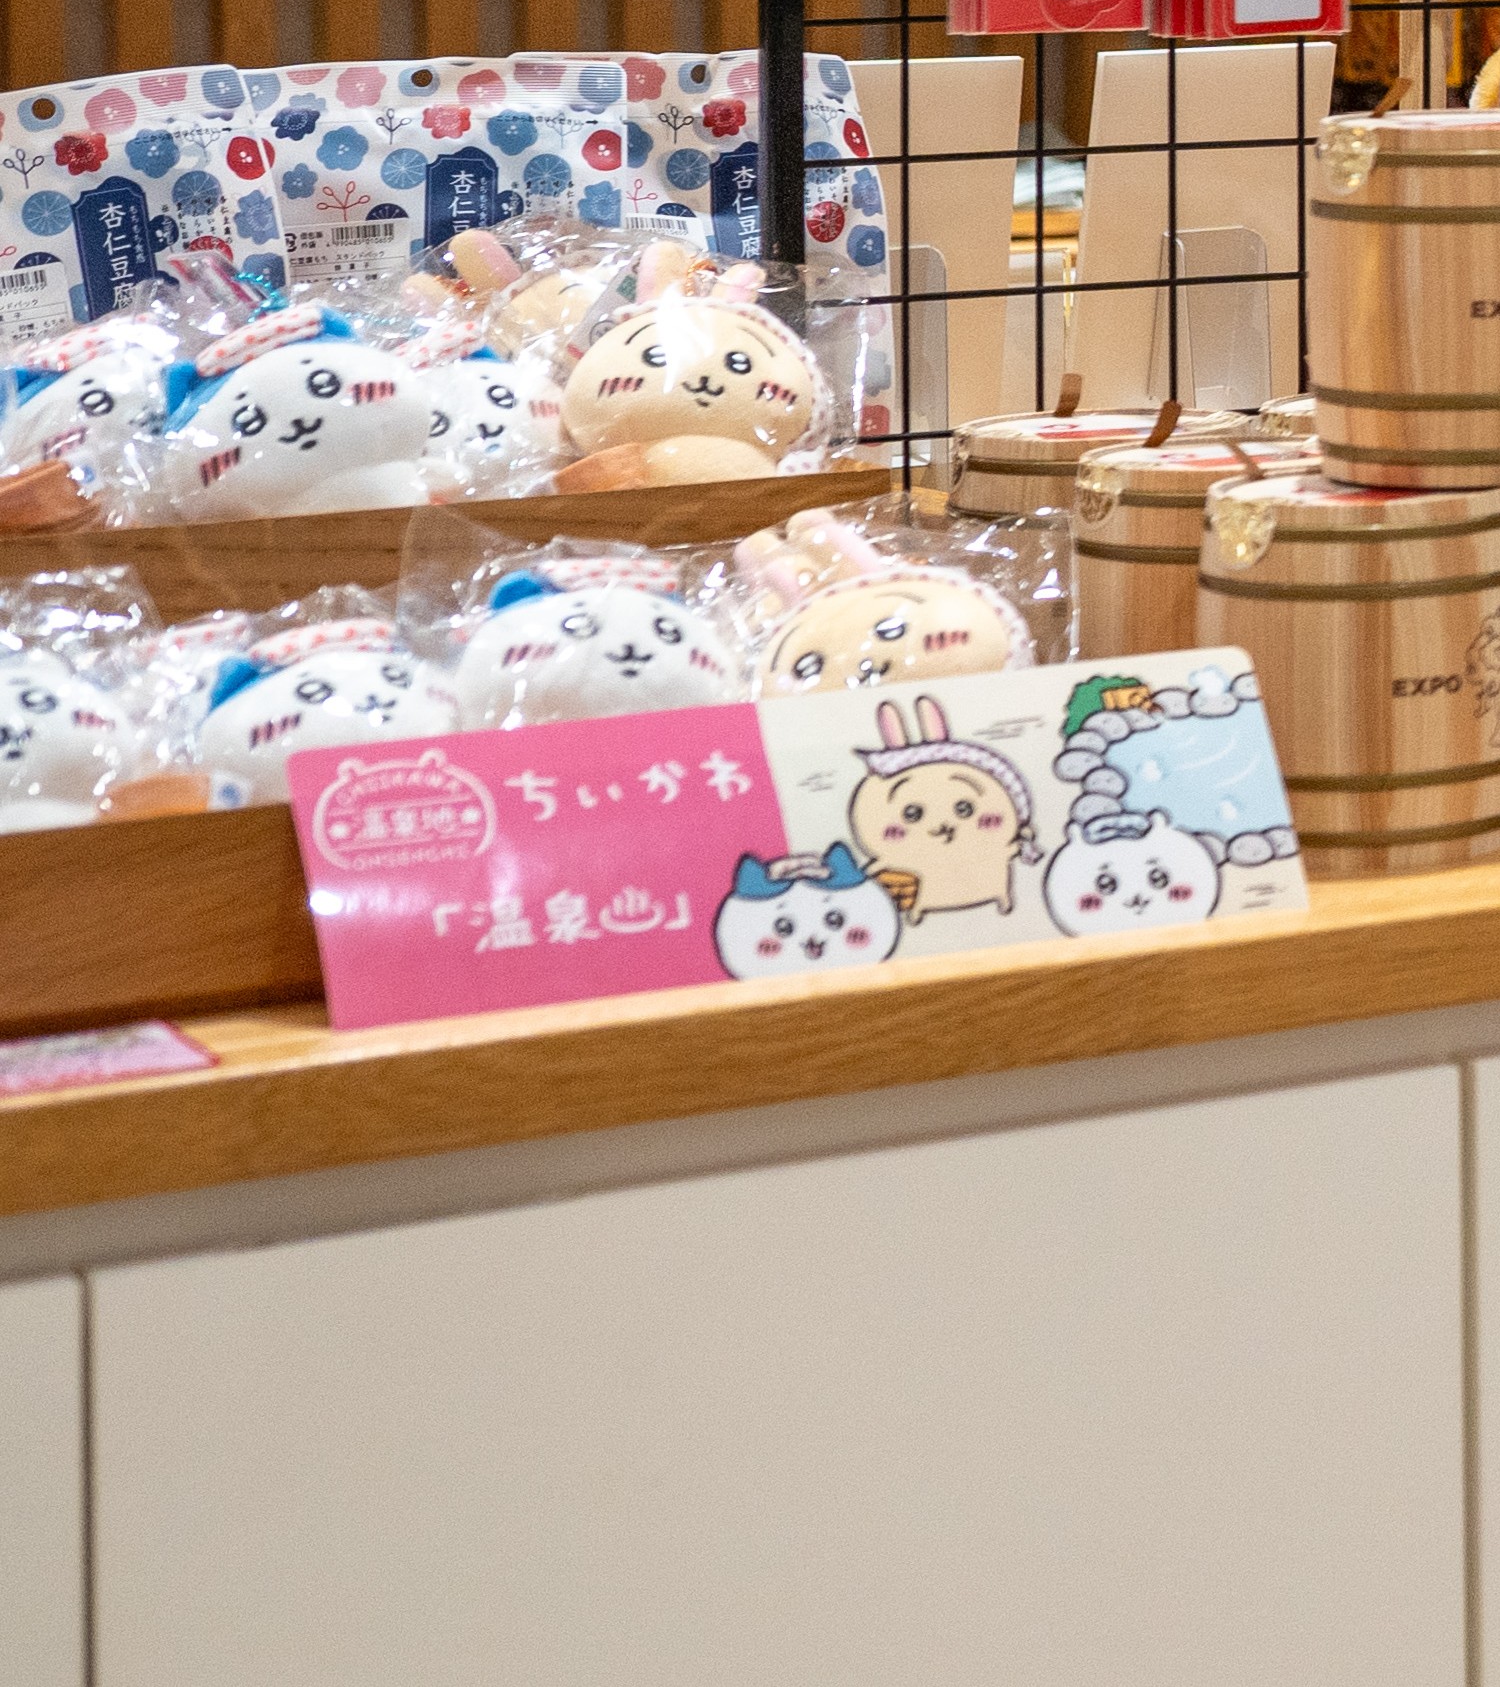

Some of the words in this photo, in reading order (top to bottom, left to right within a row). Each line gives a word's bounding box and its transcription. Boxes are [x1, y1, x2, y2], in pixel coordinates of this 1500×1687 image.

[448, 170, 477, 234] 杏仁豆
[1392, 677, 1462, 698] EXPO
[504, 750, 753, 822] ちいかわ
